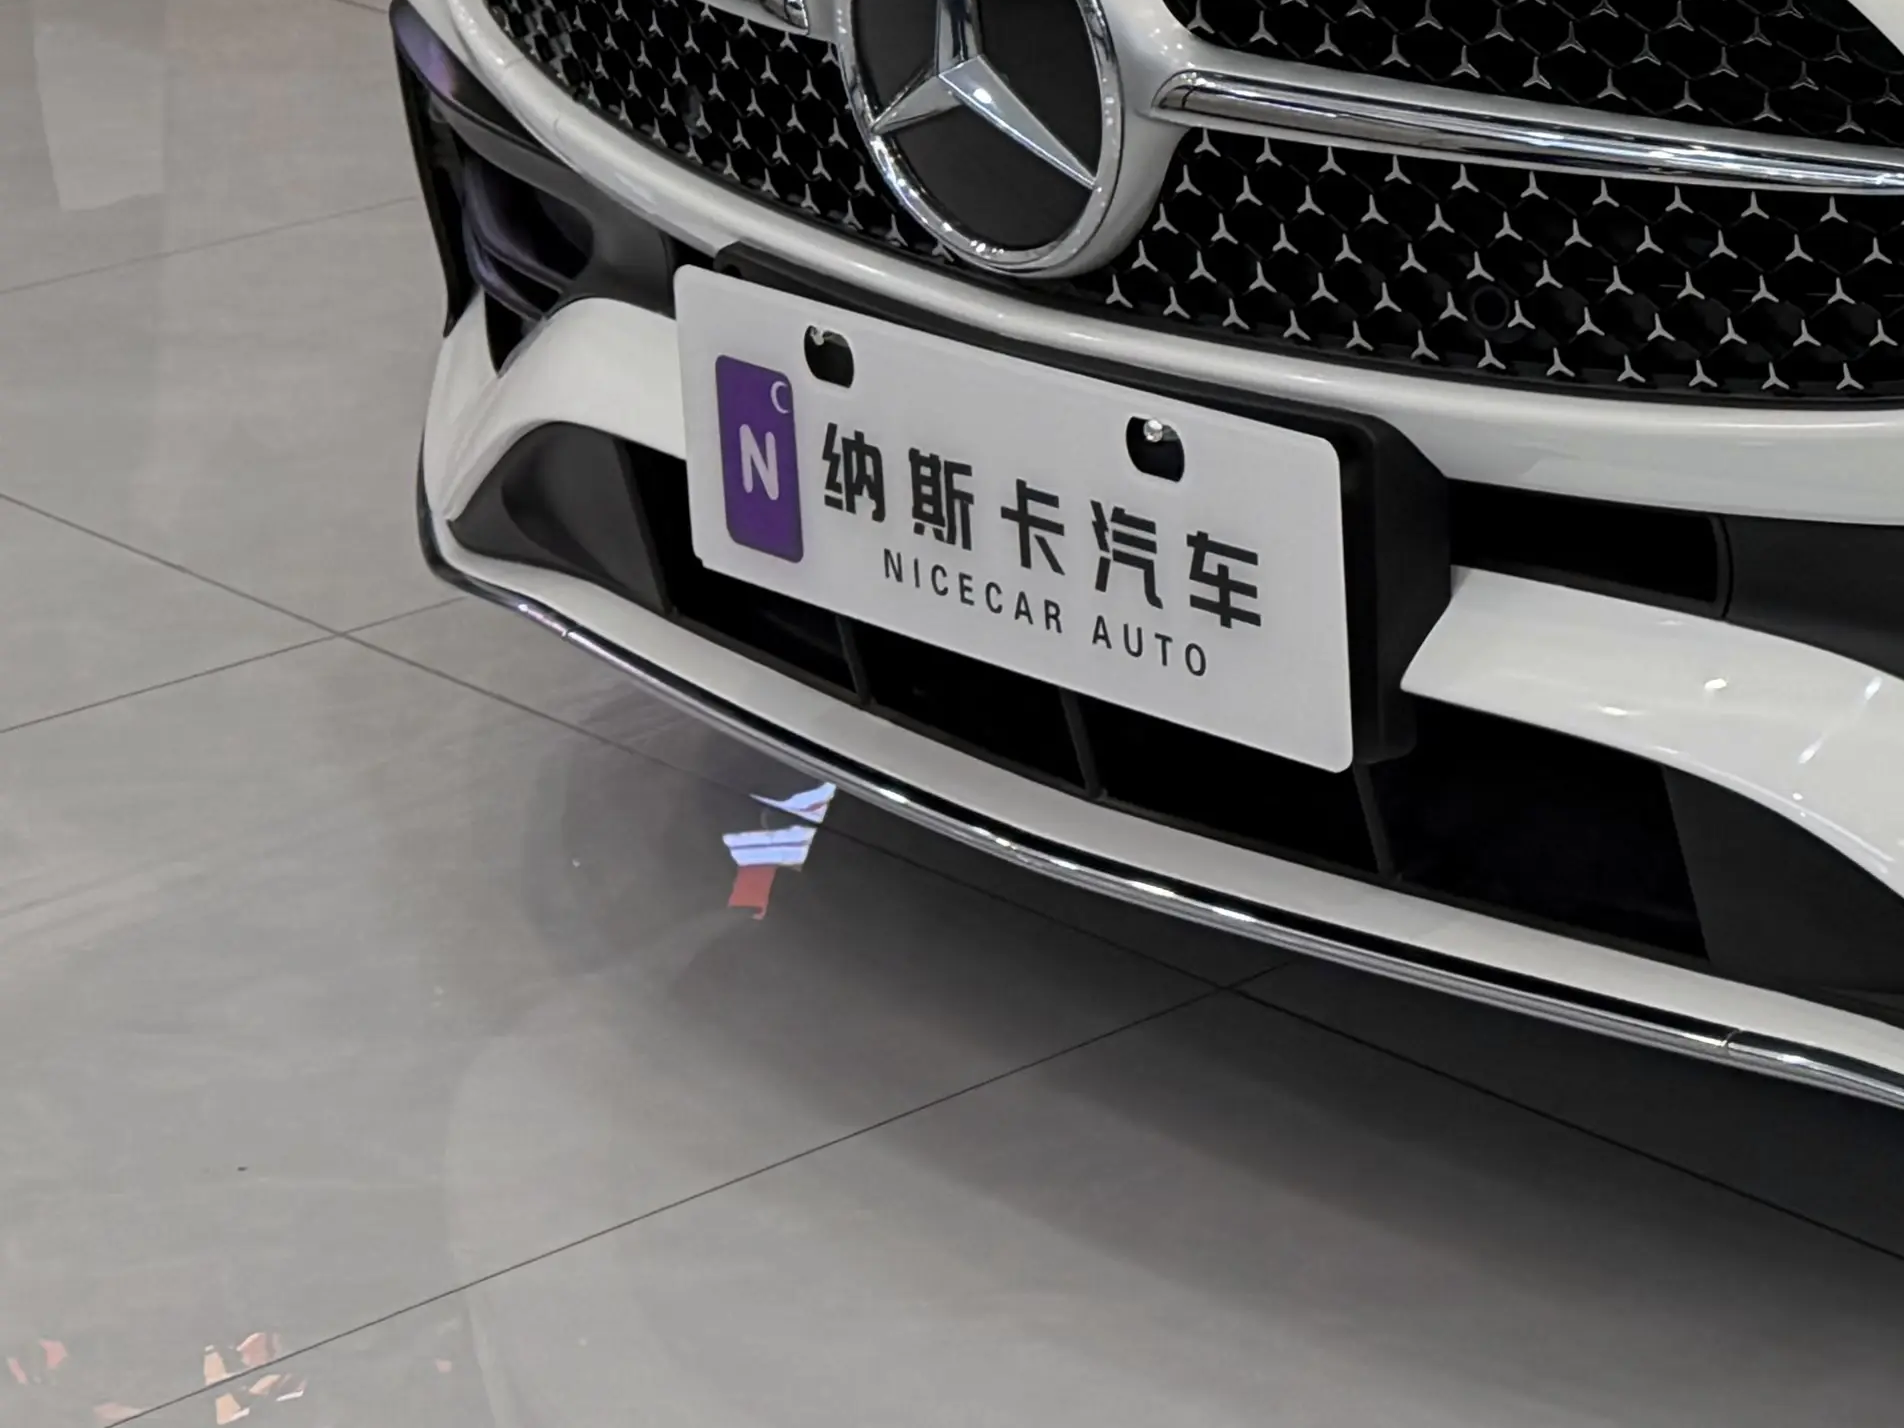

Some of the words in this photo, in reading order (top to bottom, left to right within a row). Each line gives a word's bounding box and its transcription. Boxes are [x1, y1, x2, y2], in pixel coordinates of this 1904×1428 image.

[738, 423, 779, 501] N
[820, 421, 1263, 631] 纳斯卡汽车
[884, 547, 1064, 634] NICECAR
[1091, 615, 1209, 677] AUTO
